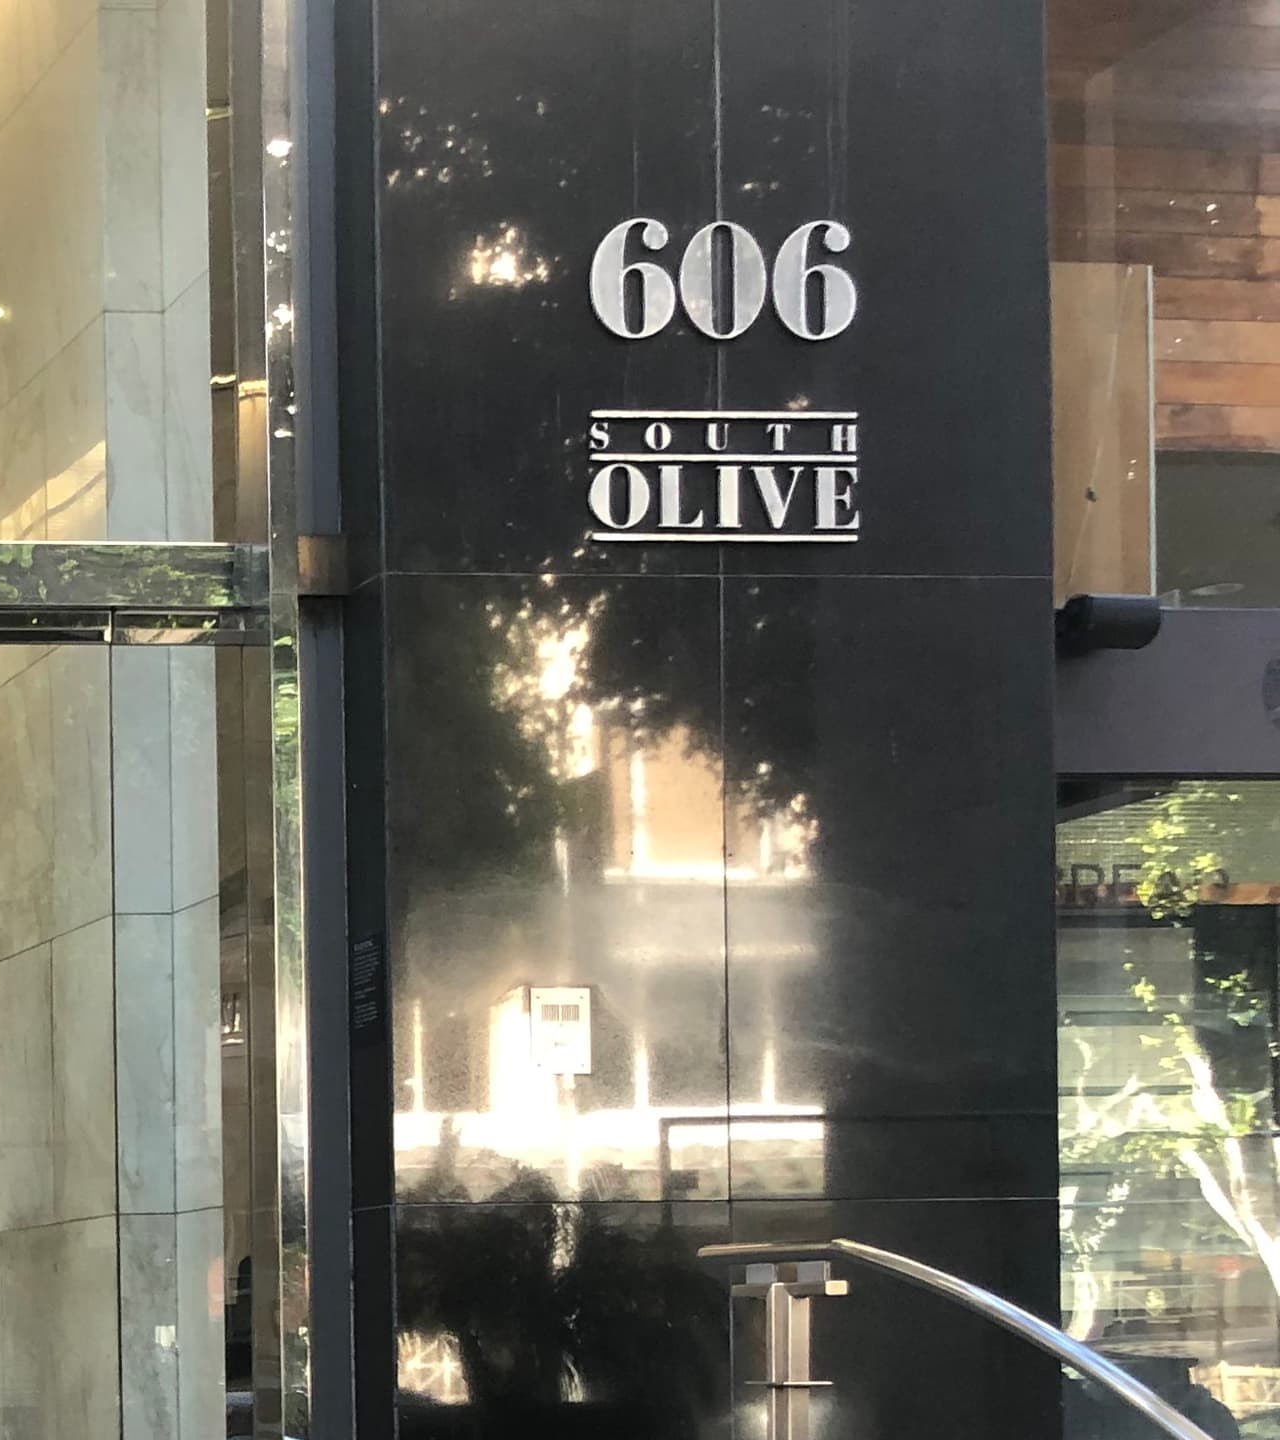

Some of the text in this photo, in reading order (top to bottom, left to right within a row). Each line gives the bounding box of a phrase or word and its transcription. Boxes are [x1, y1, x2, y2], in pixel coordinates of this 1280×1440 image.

[589, 217, 857, 341] 606
[588, 422, 858, 452] SOUTH
[588, 463, 860, 530] OLIVE
